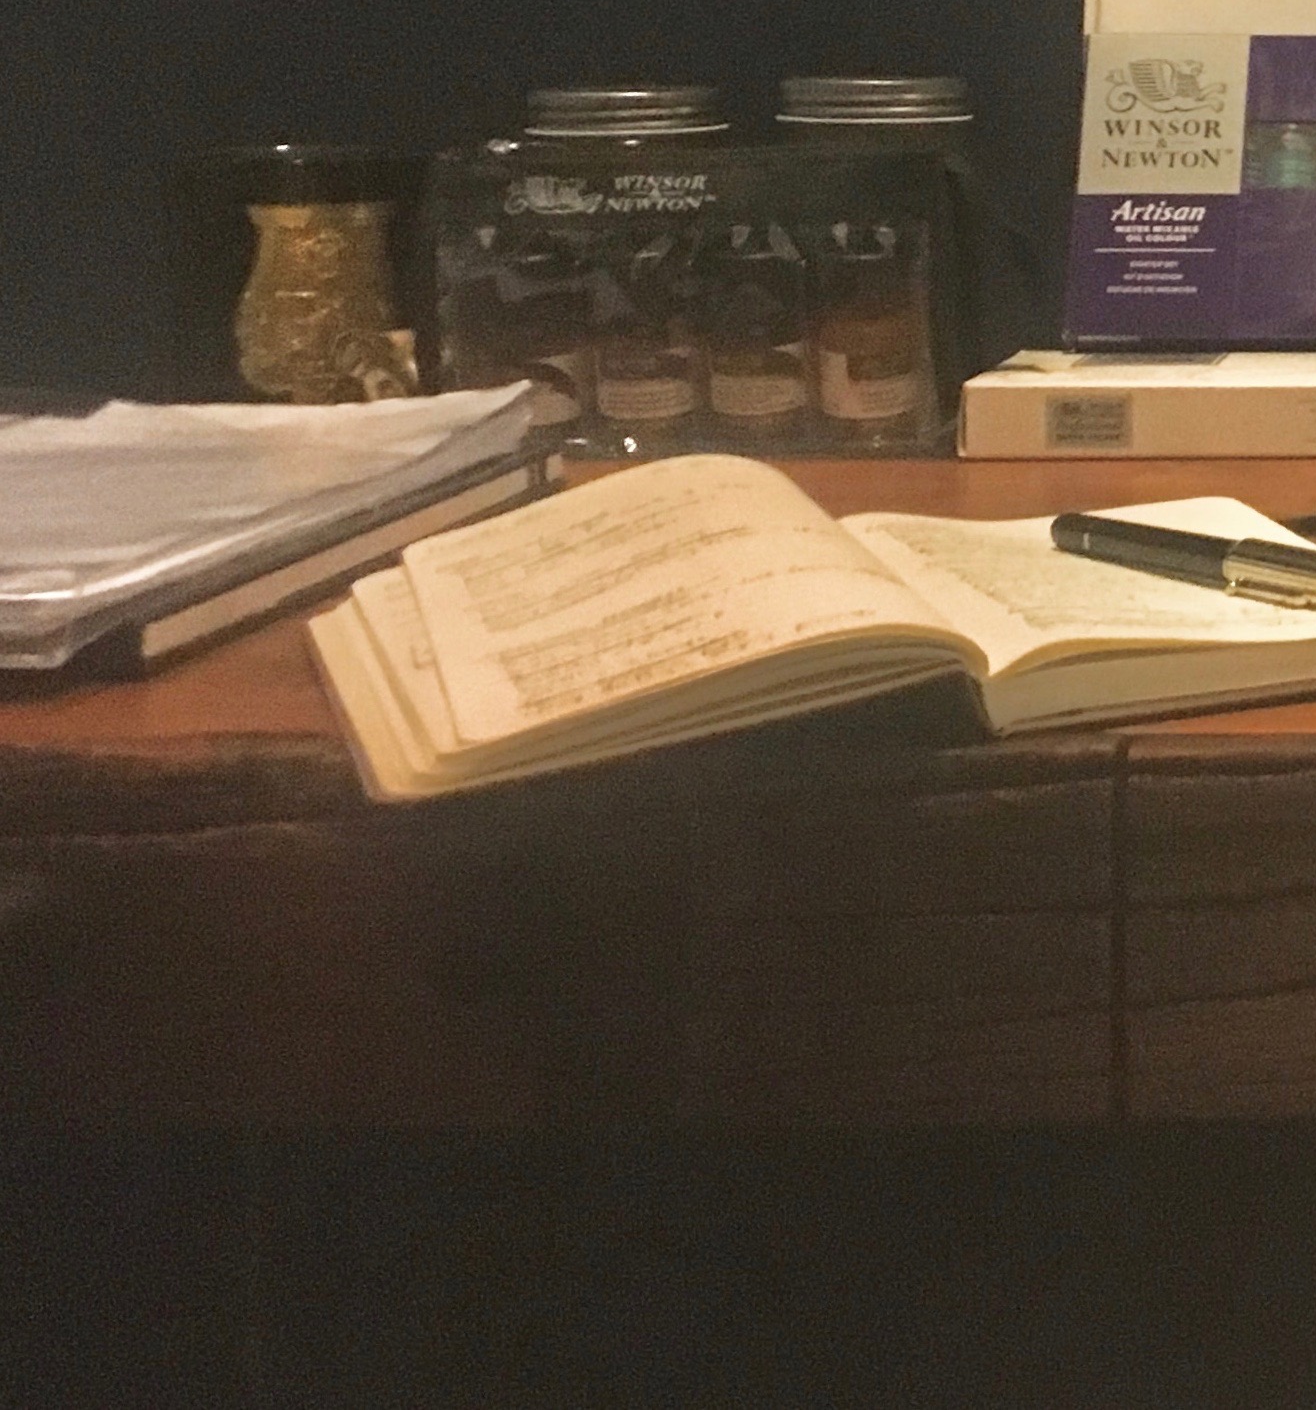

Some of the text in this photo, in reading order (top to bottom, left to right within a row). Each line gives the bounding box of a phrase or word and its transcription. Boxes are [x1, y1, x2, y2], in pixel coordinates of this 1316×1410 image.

[1103, 119, 1222, 139] WINSOR
[1101, 148, 1221, 169] NEWTON
[615, 174, 708, 191] WINSOR
[604, 195, 704, 213] NEWTON
[1110, 199, 1206, 222] Artisan
